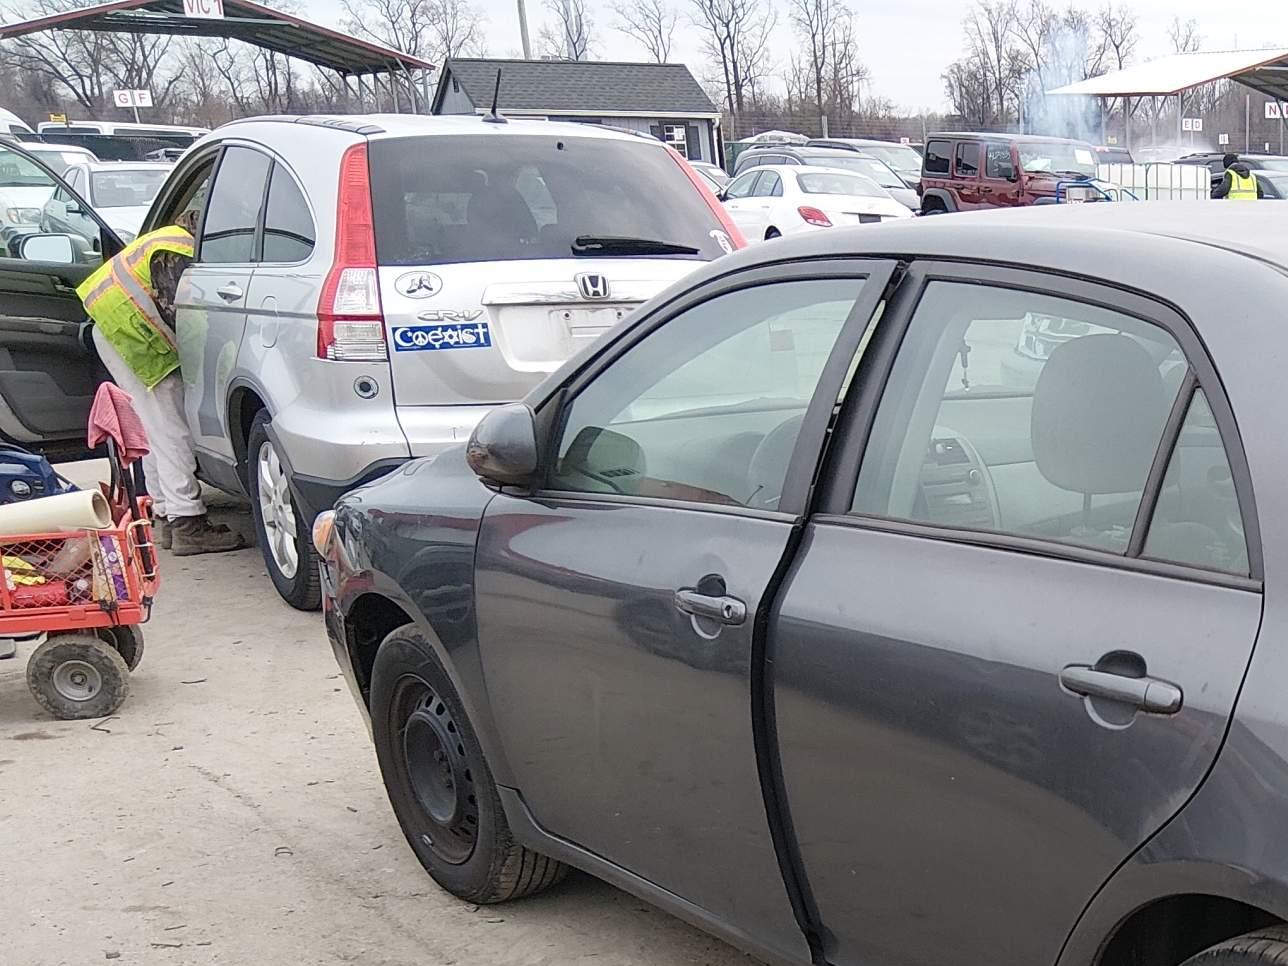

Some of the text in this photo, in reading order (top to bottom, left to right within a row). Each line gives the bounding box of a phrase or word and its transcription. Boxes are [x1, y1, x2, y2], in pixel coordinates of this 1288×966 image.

[186, 0, 211, 14] VIC
[118, 93, 146, 104] G F
[1268, 105, 1277, 116] N
